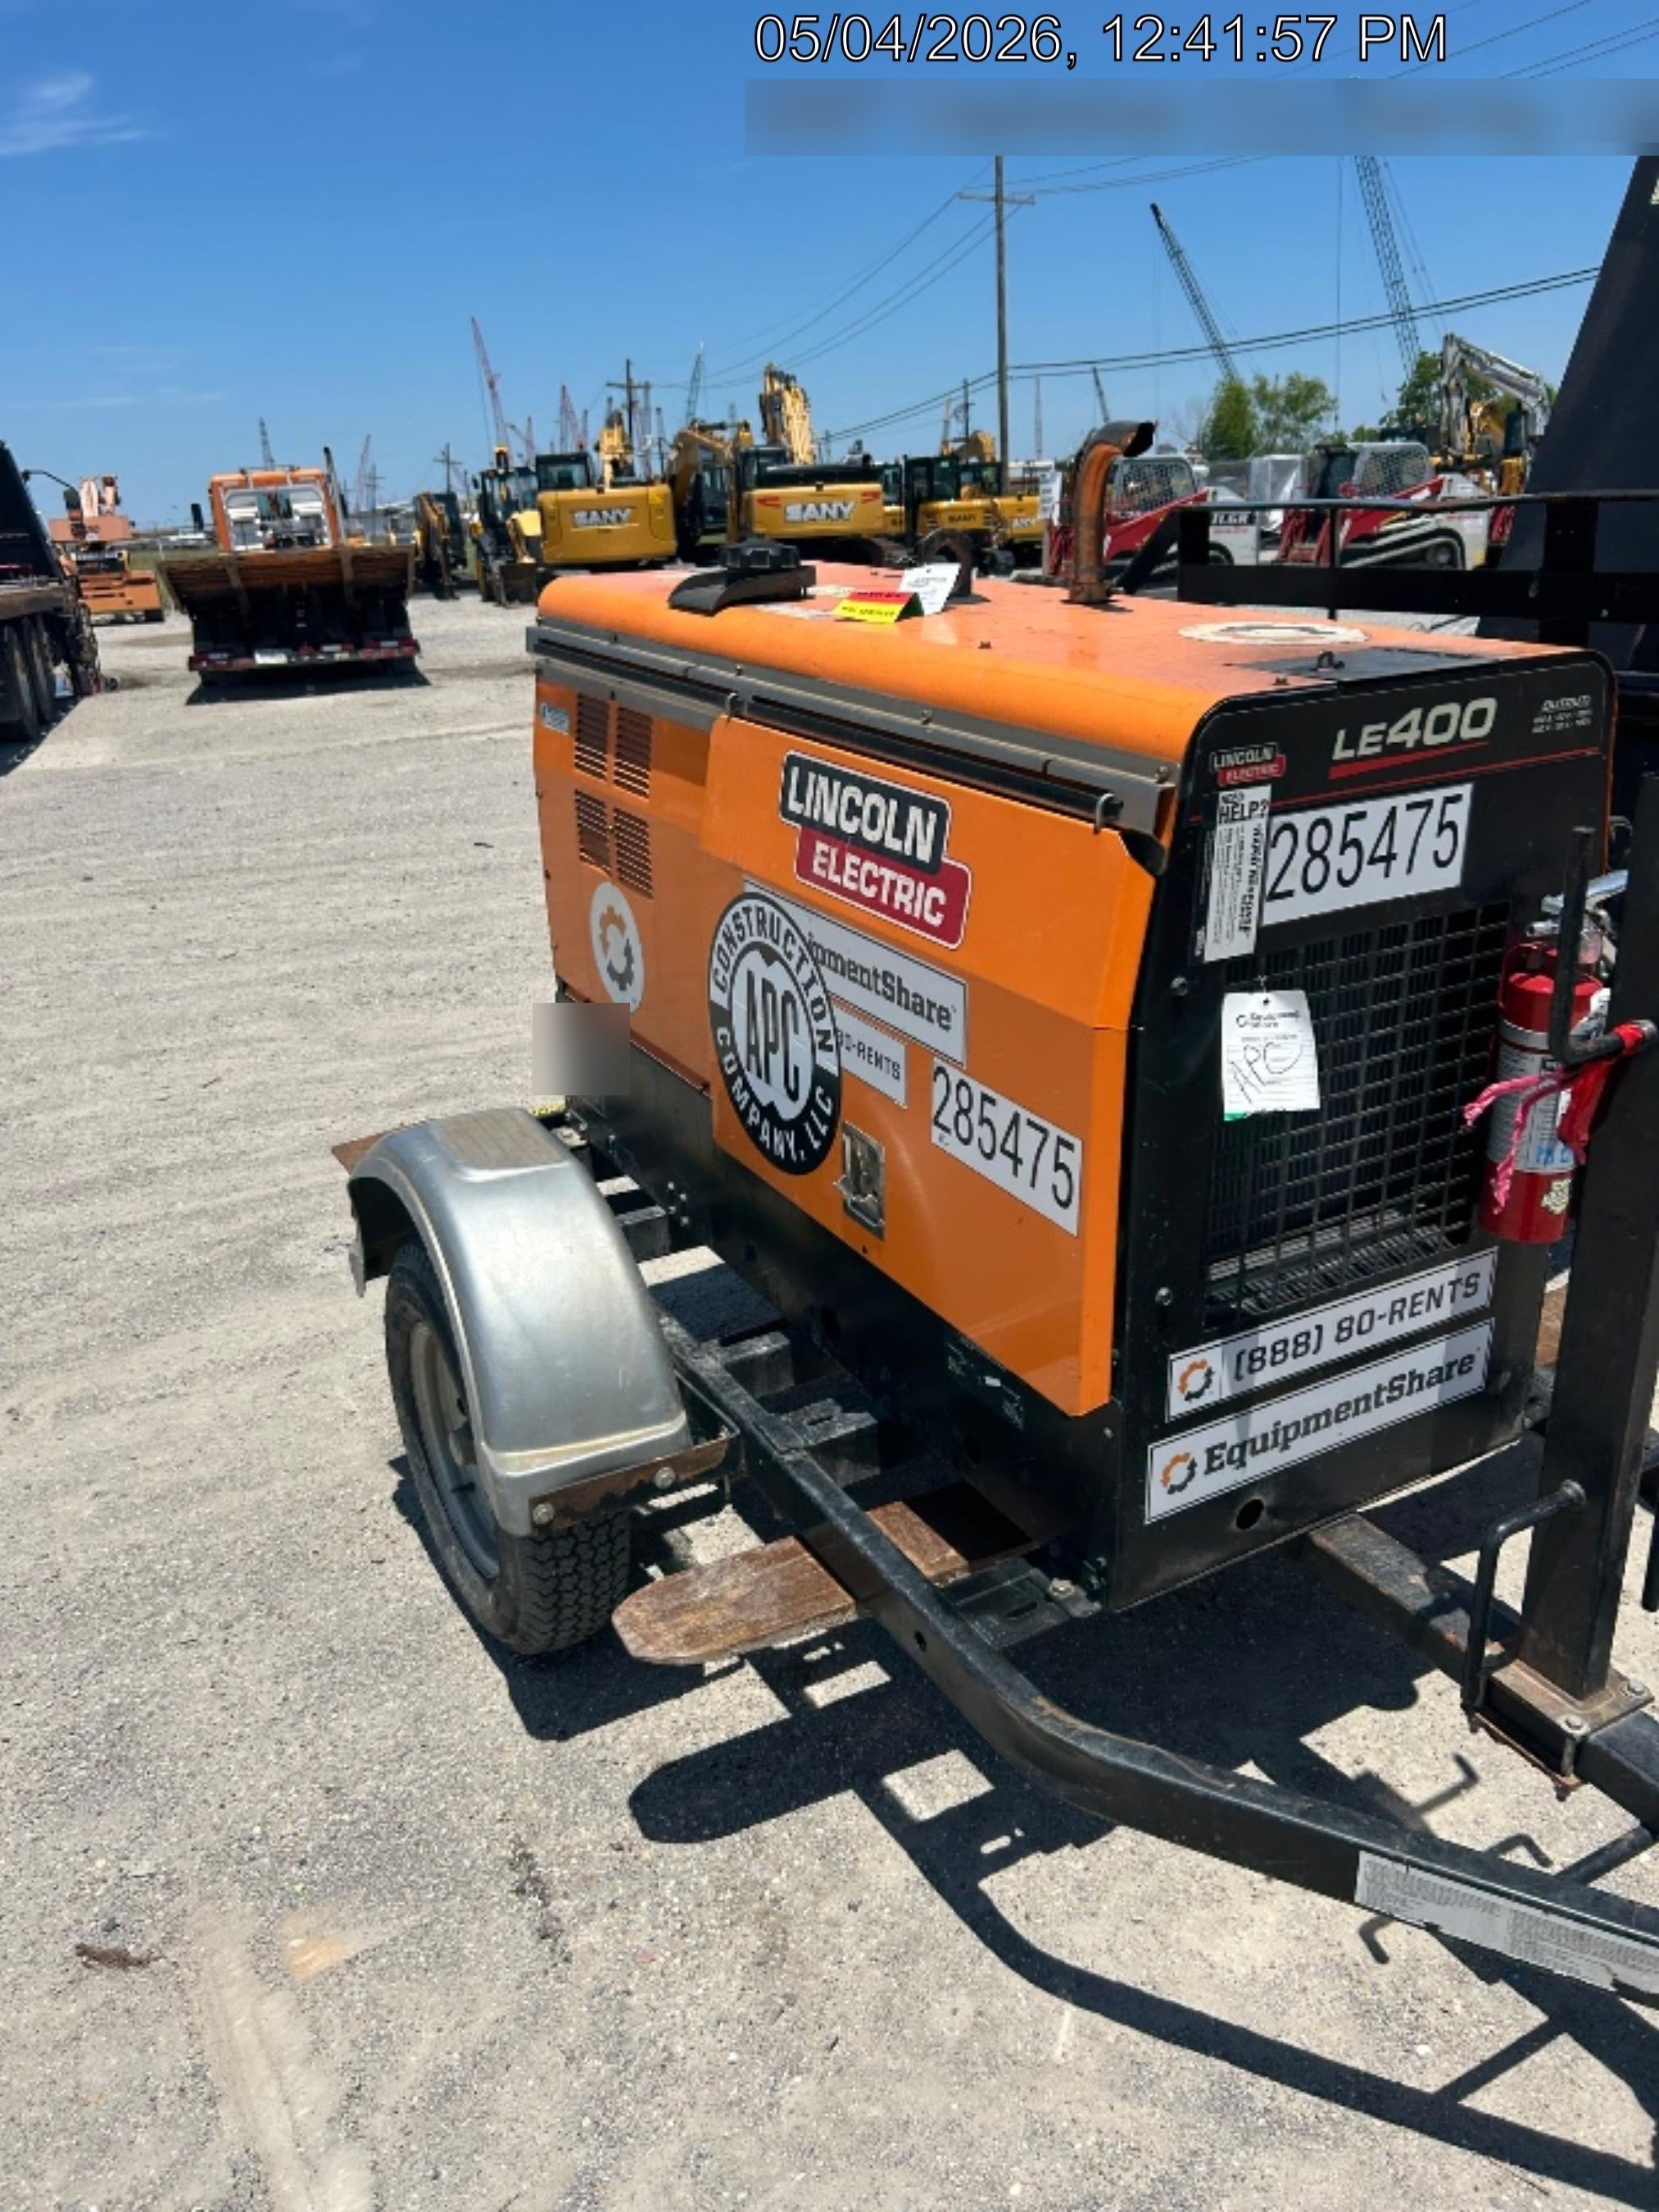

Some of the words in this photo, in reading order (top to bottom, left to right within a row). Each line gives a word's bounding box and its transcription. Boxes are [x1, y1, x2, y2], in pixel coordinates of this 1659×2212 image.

[785, 501, 855, 523] SANY
[1213, 746, 1274, 768] LINCOLN
[1226, 763, 1279, 782] ELECTRIC
[1332, 697, 1498, 760] LE400
[788, 766, 937, 863] LINCOLN
[1266, 793, 1463, 902] 285475
[813, 840, 946, 927] ELECTRIC
[714, 905, 834, 1052] CONSTRUCTION
[746, 969, 800, 1102] APC
[803, 1086, 832, 1150] LLC
[934, 1065, 1075, 1210] 285475
[1235, 1324, 1324, 1381] (888)
[1334, 1272, 1481, 1344] 80-RENTS
[1204, 1353, 1475, 1475] EquipmentShare
